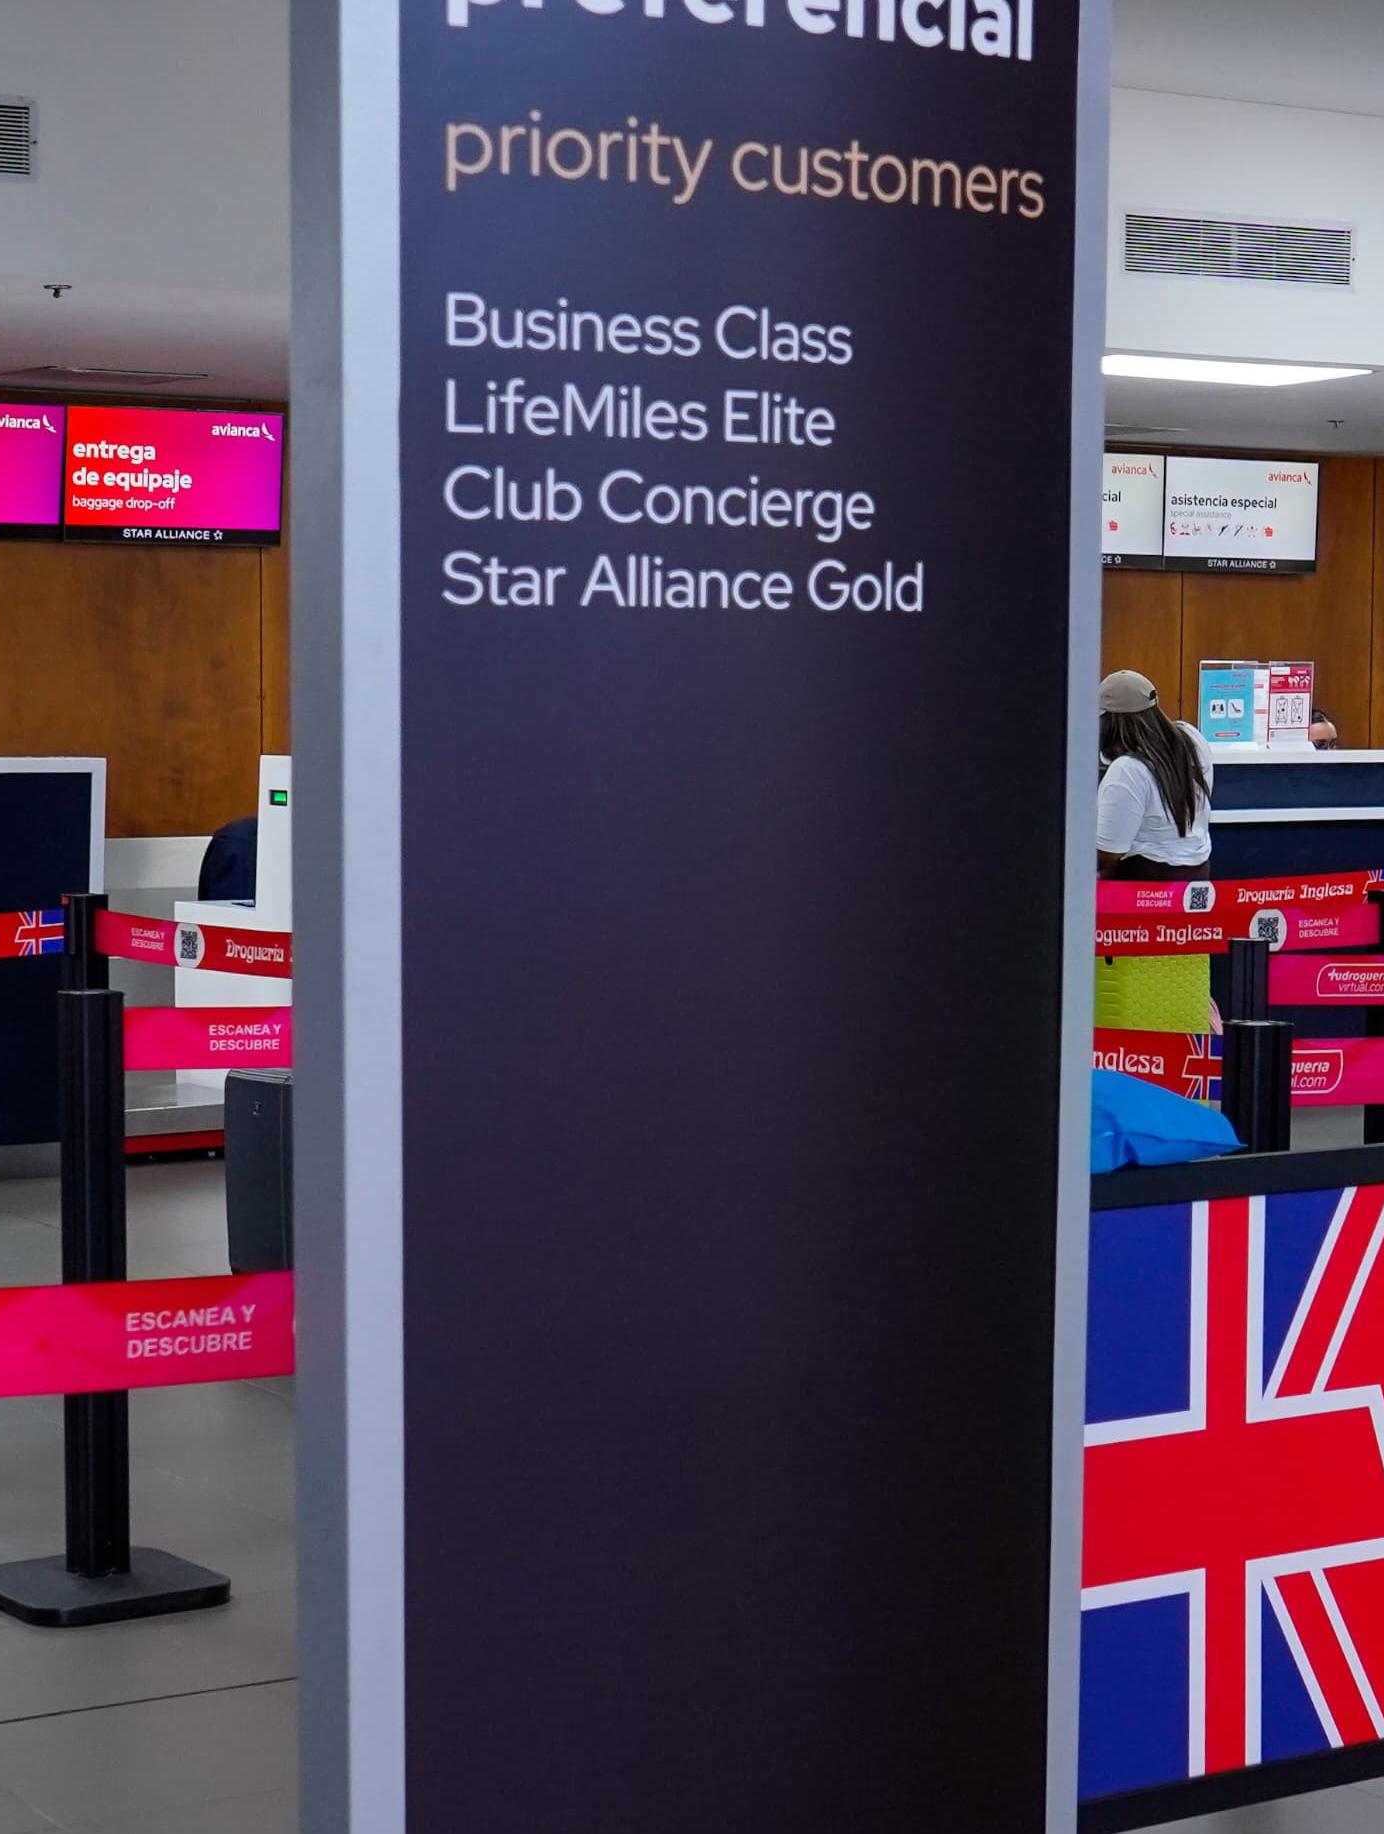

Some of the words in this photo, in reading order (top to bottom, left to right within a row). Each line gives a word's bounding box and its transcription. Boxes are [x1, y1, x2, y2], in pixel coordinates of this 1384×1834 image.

[444, 110, 714, 205] priority
[730, 140, 1047, 218] customers
[444, 292, 702, 357] Business
[716, 305, 853, 366] Class
[444, 379, 709, 442] LifeMiles
[723, 390, 836, 447] Elite
[212, 423, 260, 437] avianca
[73, 440, 156, 464] entrega
[72, 467, 99, 486] de
[103, 469, 192, 493] equipaje
[1111, 464, 1147, 476] avianca
[1268, 472, 1302, 483] avianca
[72, 495, 123, 510] baggage
[126, 497, 175, 511] drop-off
[442, 465, 582, 522] Club
[598, 469, 875, 543] Concierge
[1171, 493, 1228, 507] asistencia
[1231, 497, 1277, 511] especial
[1170, 510, 1194, 518] special
[1196, 510, 1232, 519] assistance
[123, 528, 152, 538] STAR
[155, 530, 210, 540] ALLIANCE
[1230, 561, 1268, 569] ALLIANCE
[441, 551, 567, 606] Star
[579, 554, 793, 611] Alliance
[807, 559, 924, 612] Gold
[1237, 885, 1295, 905] Droguería
[1299, 882, 1354, 900] Inglesa
[1095, 923, 1150, 946] oguería
[1156, 924, 1224, 945] Inglesa
[1298, 917, 1332, 929] ESCANEA
[1298, 928, 1339, 938] DESCUBRE
[225, 939, 284, 963] Droguería
[208, 1025, 269, 1037] ESCANEA
[271, 1025, 282, 1035] Y
[209, 1038, 280, 1051] DESCUBRE
[1092, 1046, 1165, 1076] nglesa
[125, 1305, 235, 1332] ESCANEA
[240, 1304, 257, 1324] Y
[126, 1331, 253, 1359] DESCUBRE
